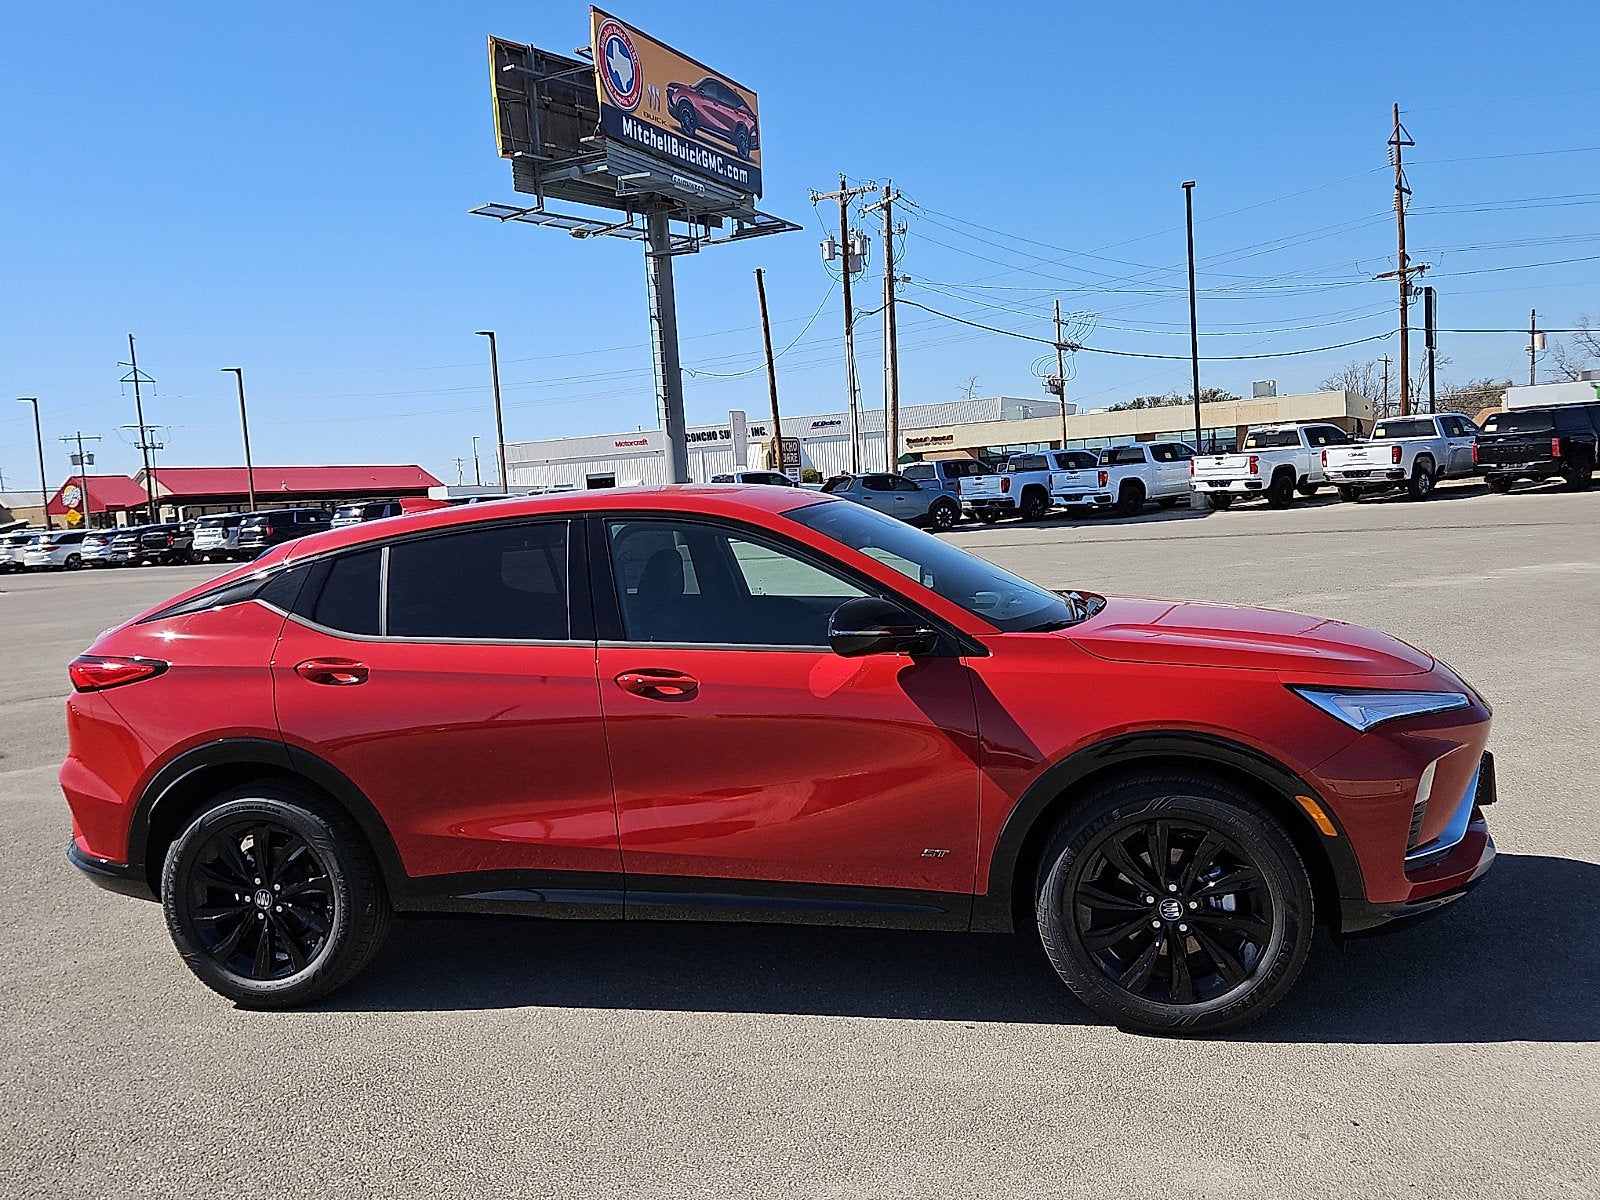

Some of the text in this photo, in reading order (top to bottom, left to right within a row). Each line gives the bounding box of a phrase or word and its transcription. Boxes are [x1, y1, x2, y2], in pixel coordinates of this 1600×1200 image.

[643, 111, 667, 126] BUICK
[622, 116, 748, 184] MitchellBuickGMC.com
[615, 438, 648, 447] Motorcraft
[685, 430, 718, 443] CONCHO
[751, 426, 768, 437] INC.
